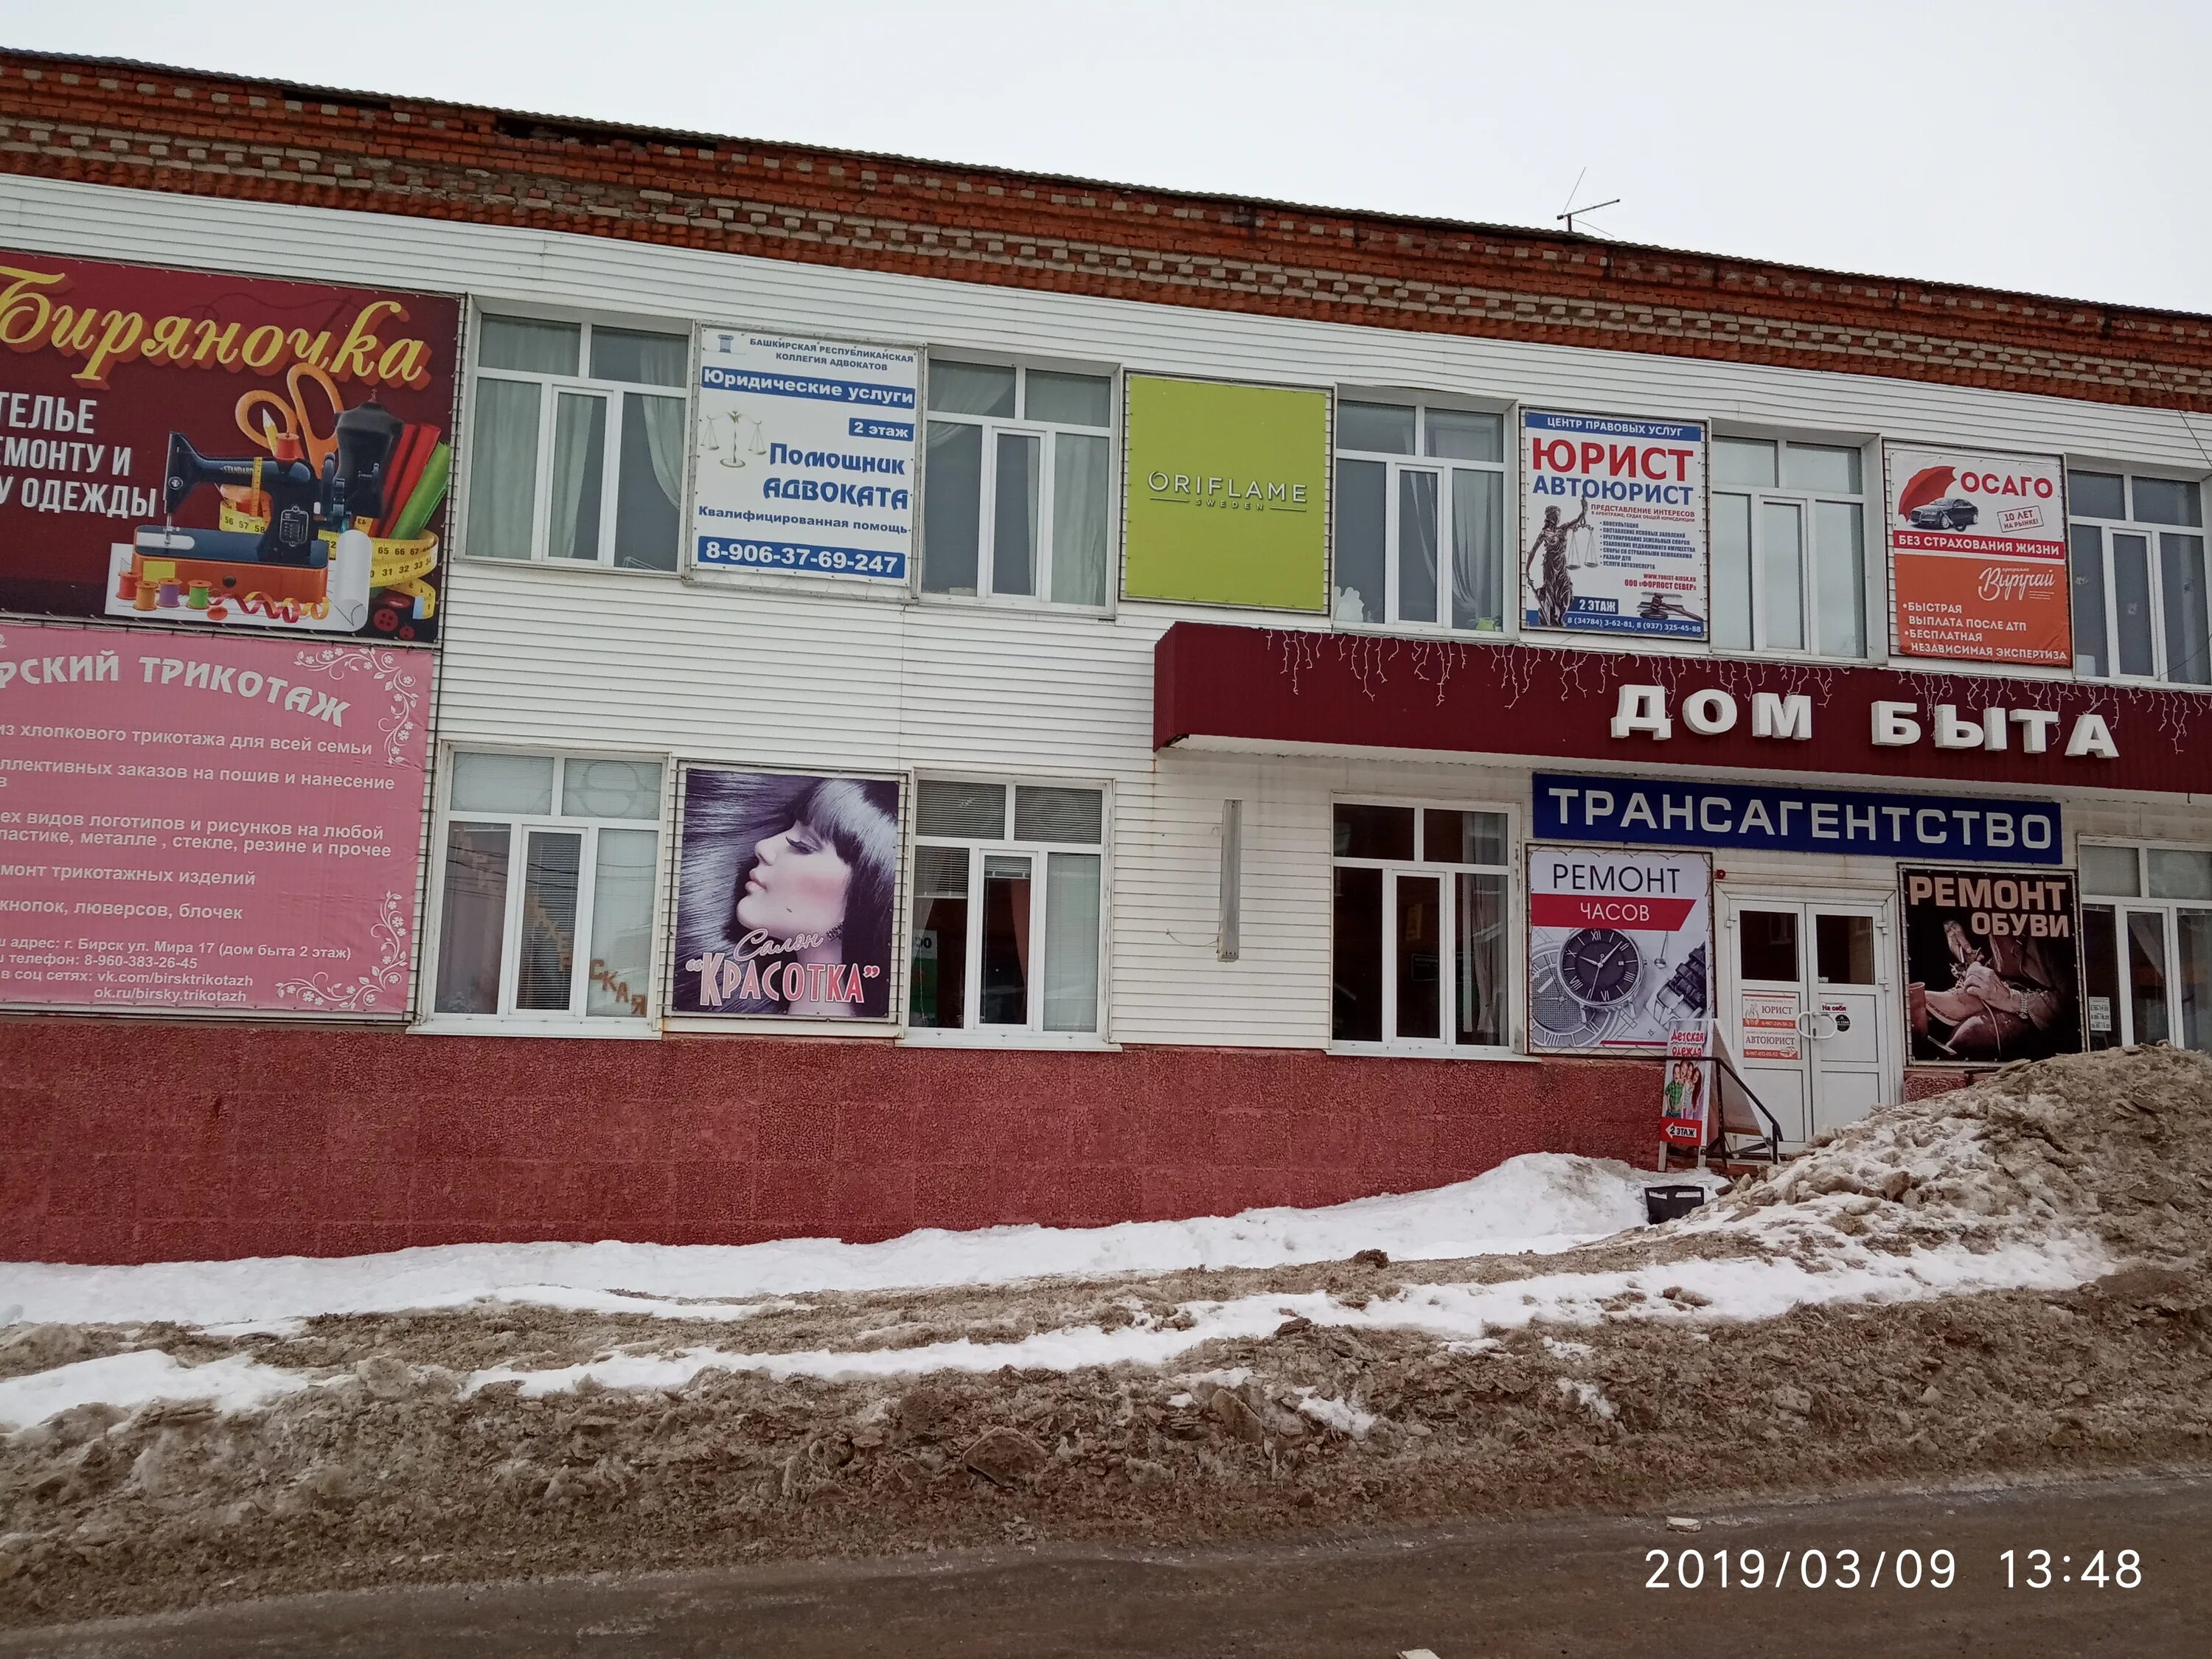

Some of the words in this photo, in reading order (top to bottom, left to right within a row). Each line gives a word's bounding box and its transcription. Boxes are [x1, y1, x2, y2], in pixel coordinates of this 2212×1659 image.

[750, 338, 816, 352] БАШКИРСКАЯ
[819, 346, 914, 363] РЕСПУБЛИКАНСКАЯ
[776, 352, 827, 365] КОЛЛЕГИЯ
[830, 359, 888, 371] АДВОКАТОВ
[704, 369, 843, 397] Юридические
[848, 387, 914, 406] услуги
[854, 422, 864, 434] 2
[869, 425, 908, 439] этаж
[1547, 417, 1583, 429] ЦЕНТР
[1585, 420, 1646, 434] ПРАВОВЫХ
[1649, 425, 1683, 437] УСЛУГ
[111, 448, 132, 476] И
[770, 442, 905, 476] Помощник
[1532, 437, 1694, 481] ЮРИСТ
[763, 477, 908, 511] АДВОКАТА
[1148, 470, 1307, 503] ORIFLAME
[1532, 475, 1694, 506] АВТОЮРИСТ
[1960, 471, 2053, 498] ОСАГО
[21, 477, 156, 518] ОДЕЖДЫ
[1195, 498, 1264, 510] SWEDEN
[698, 506, 849, 529] Квалифицированная
[852, 521, 908, 535] помощь
[1591, 504, 1652, 514] ПРЕДСТАВЛЕНИЕ
[1654, 509, 1695, 517] ИНТЕРЕСОВ
[2005, 513, 2014, 521] 10
[2017, 509, 2033, 520] ЛЕТ
[225, 516, 234, 525] 56
[254, 524, 265, 534] 58
[2014, 518, 2039, 527] РЫНКЕ!
[1899, 535, 1921, 546] БЕЗ
[1924, 537, 2013, 552] СТРАХОВАНИЯ
[2016, 542, 2059, 555] ЖИЗНИ
[706, 542, 898, 574] 8-906-37-69-247
[1624, 579, 1637, 587] ООО
[1639, 581, 1672, 589] «ФОРПОСТ
[1674, 582, 1697, 591] СЕВЕР»
[1978, 567, 2055, 601] Выручай
[1579, 599, 1585, 610] 2
[1587, 599, 1615, 612] ЭТАЖ
[1907, 602, 1962, 614] БЫСТРАЯ
[1574, 617, 1602, 626] (34784)
[1643, 622, 1663, 630] (937)
[1664, 624, 1701, 633] 325-45-88
[1909, 616, 1963, 627] ВЫПЛАТА
[1966, 619, 2003, 631] ПОСЛЕ
[2006, 621, 2026, 632] ДТП
[1910, 629, 1983, 641] БЕСПЛАТНАЯ
[1911, 642, 1993, 656] НЕЗАВИСИМАЯ
[1996, 647, 2067, 660] ЭКСПЕРТИЗА
[139, 655, 352, 728] ТРИКОТАЖ
[1610, 683, 1812, 740] ДОМ
[1871, 699, 2120, 759] БЫТА
[20, 726, 126, 741] хлопкового
[132, 731, 225, 747] трикотажа
[230, 737, 264, 749] для
[271, 737, 312, 751] всей
[317, 740, 372, 754] семьи
[117, 765, 187, 779] заказов
[193, 768, 214, 780] на
[220, 770, 279, 783] пошив
[285, 773, 295, 784] и
[301, 774, 395, 790] нанесение
[27, 813, 84, 827] видов
[89, 815, 184, 830] логотипов
[190, 820, 201, 830] и
[206, 821, 292, 836] рисунков
[297, 825, 318, 836] на
[323, 824, 383, 839] любой
[1548, 787, 2053, 850] ТРАНСАГЕНТСТВО
[173, 836, 237, 852] стекле,
[243, 838, 306, 853] резине
[312, 843, 322, 854] и
[328, 843, 392, 858] прочее
[1, 865, 46, 877] монт
[52, 866, 173, 883] трикотажных
[178, 870, 256, 885] изделий
[1553, 863, 1680, 894] РЕМОНТ
[1909, 875, 2066, 911] РЕМОНТ
[0, 900, 68, 916] кнопок,
[74, 902, 173, 919] люверсов,
[178, 903, 243, 919] блочек
[1580, 902, 1649, 922] ЧАСОВ
[1971, 911, 2070, 937] ОБУВИ
[10, 939, 60, 950] адрес:
[64, 940, 73, 949] г.
[77, 938, 123, 952] Бирск
[128, 942, 149, 953] ул.
[154, 941, 193, 955] Мира
[198, 942, 215, 953] 17
[219, 943, 253, 957] (дом
[258, 945, 295, 956] быта
[299, 946, 307, 957] 2
[312, 947, 351, 961] этаж)
[734, 928, 824, 961] Салон
[9, 953, 79, 967] телефон:
[84, 955, 198, 969] 8-960-383-26-45
[1, 970, 10, 979] в
[14, 970, 42, 981] соц
[46, 971, 92, 981] сетях:
[98, 970, 253, 987] vk.com/birsktrikotazh
[94, 987, 246, 1003] ok.ru/birsky.trikotazh
[1761, 1006, 1792, 1015] ЮРИСТ
[1670, 1029, 1705, 1043] Детская
[1746, 1036, 1795, 1046] АВТОЮРИСТ
[1669, 1125, 1675, 1135] 2
[1676, 1128, 1695, 1137] ЭТАЖ
